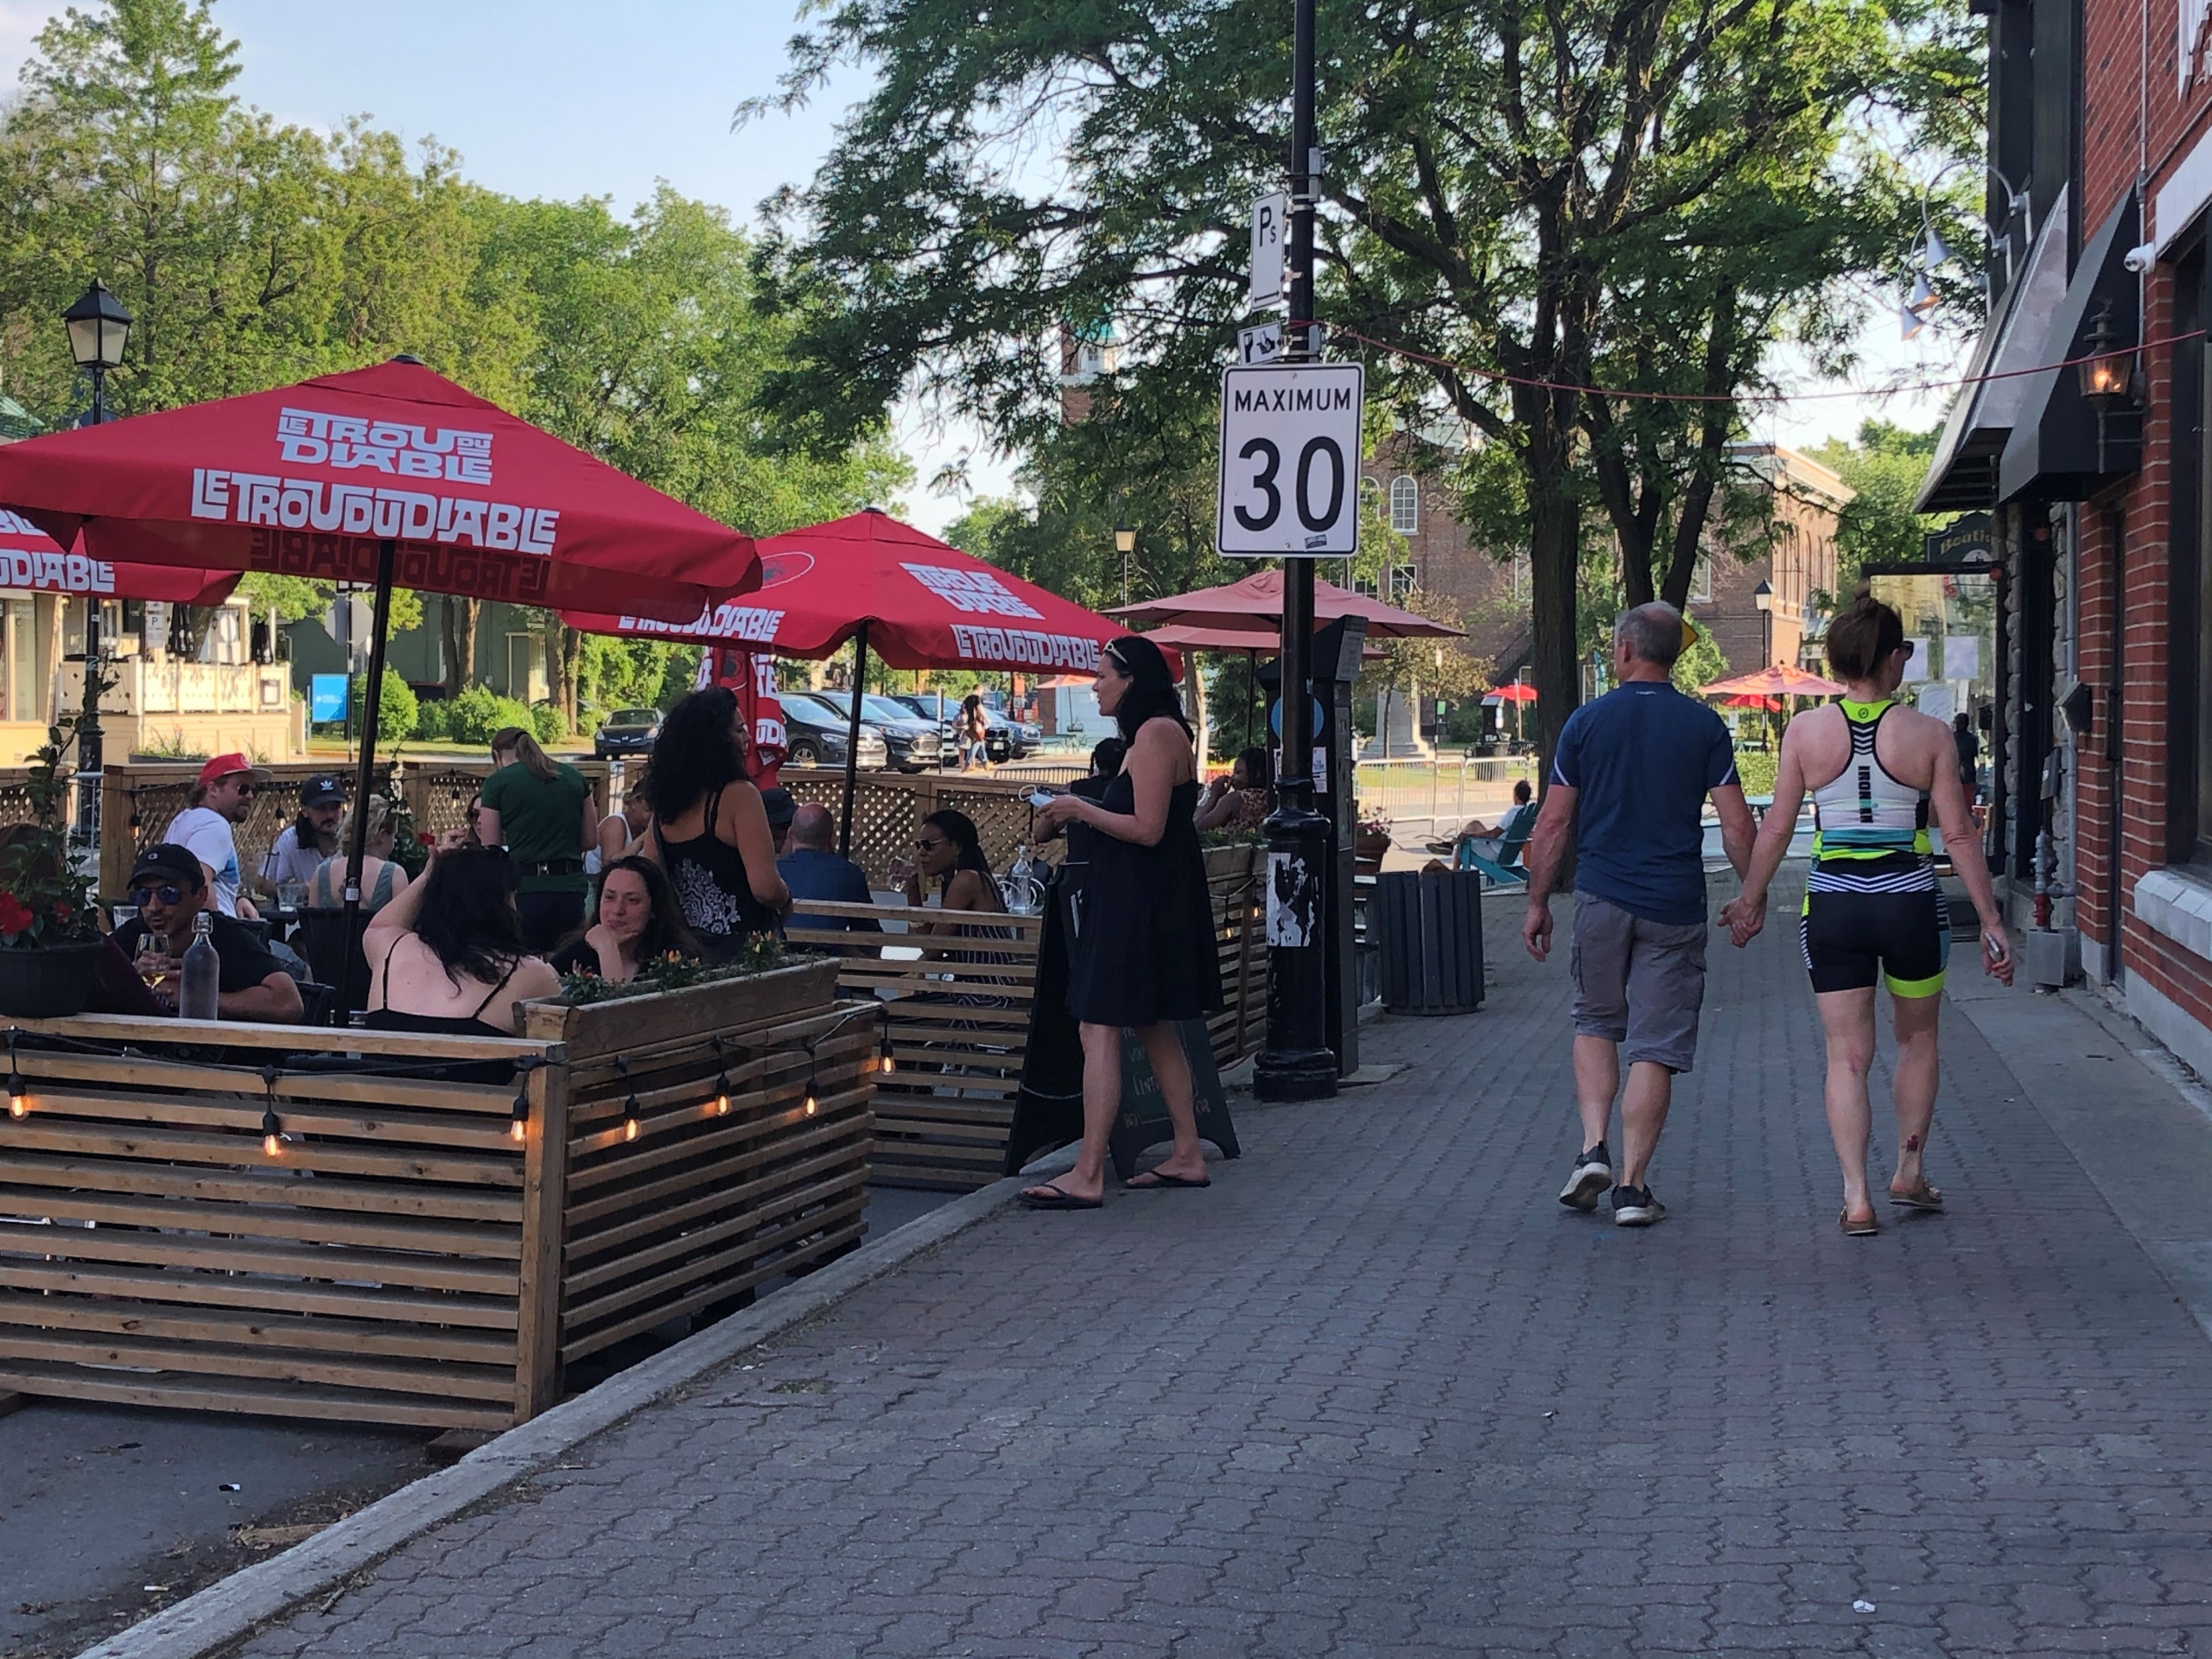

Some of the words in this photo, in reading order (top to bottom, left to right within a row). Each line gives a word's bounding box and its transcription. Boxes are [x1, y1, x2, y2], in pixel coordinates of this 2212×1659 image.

[1235, 388, 1351, 412] MAXIMUM
[276, 433, 493, 486] DIABLE
[1233, 435, 1344, 532] 30
[152, 616, 158, 626] P
